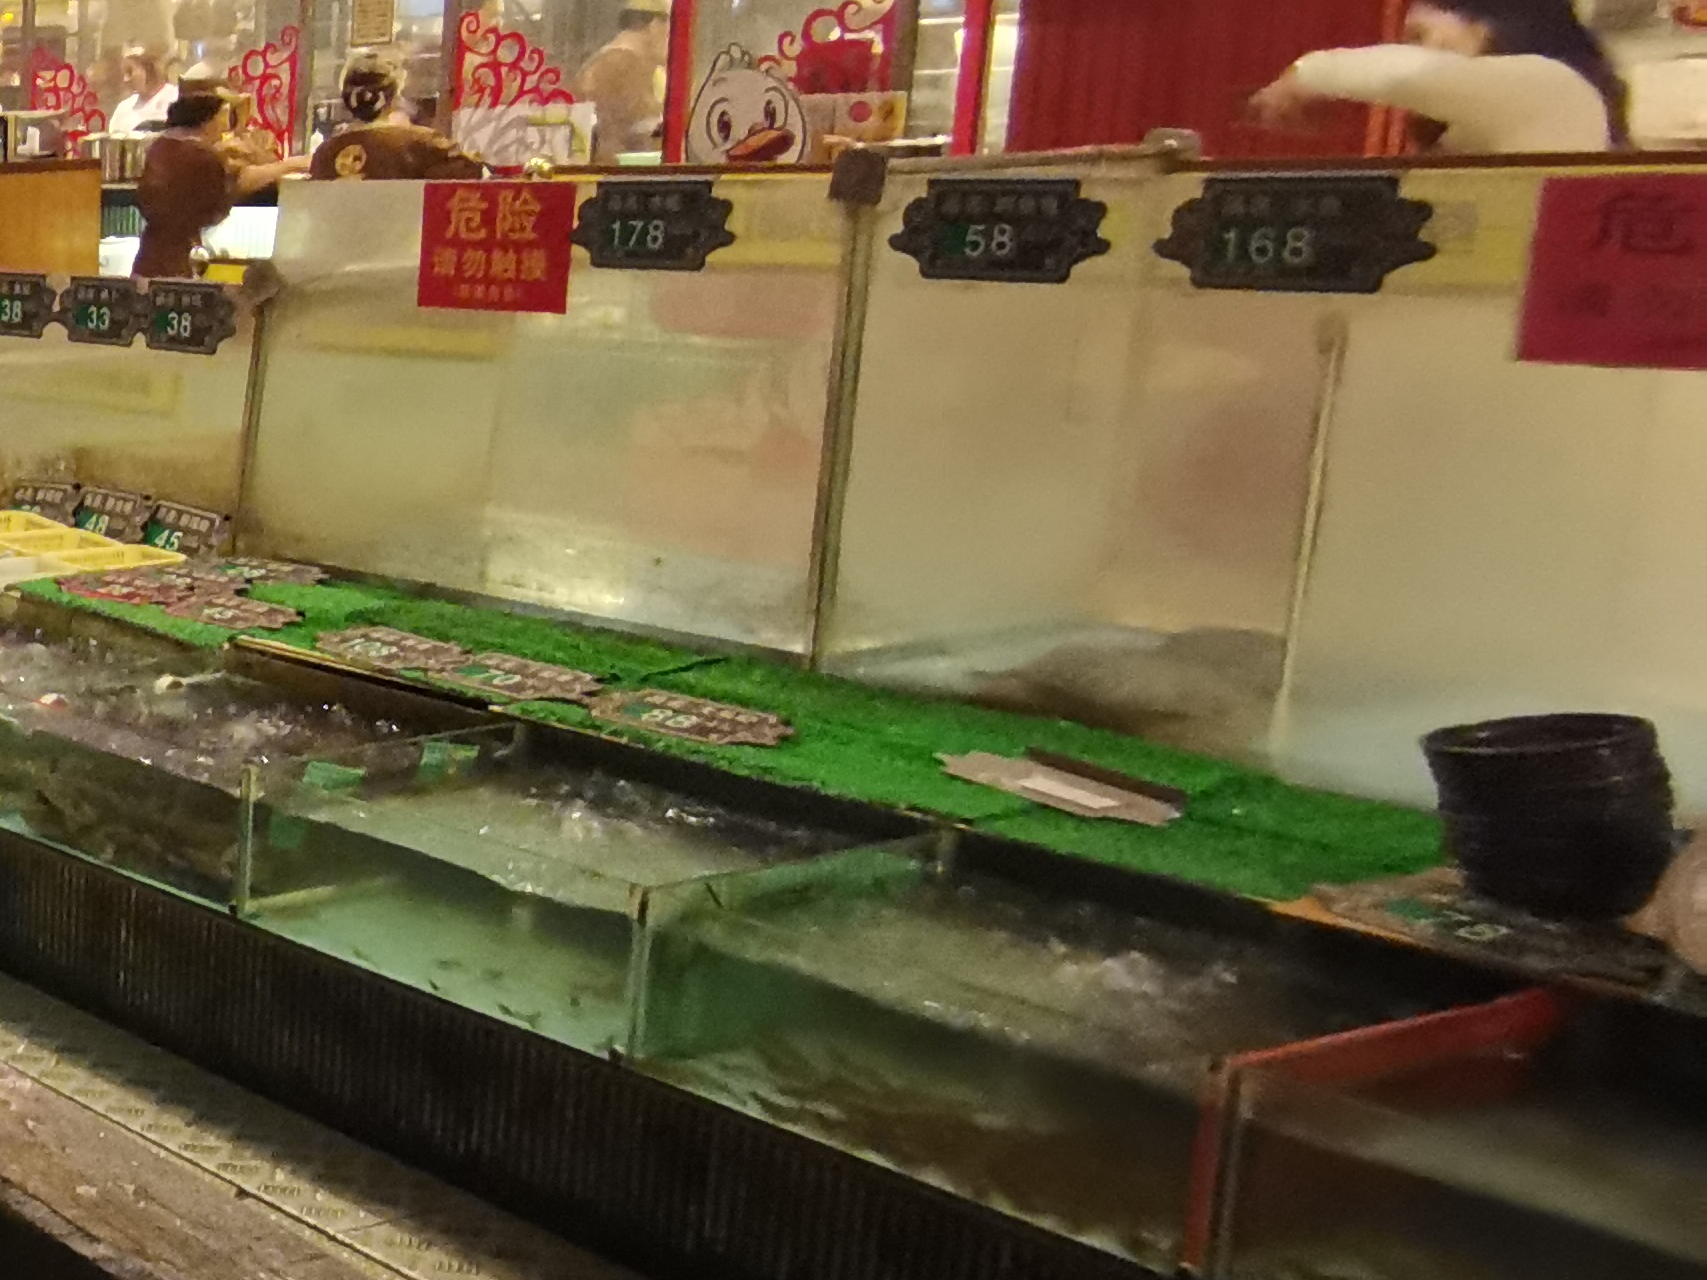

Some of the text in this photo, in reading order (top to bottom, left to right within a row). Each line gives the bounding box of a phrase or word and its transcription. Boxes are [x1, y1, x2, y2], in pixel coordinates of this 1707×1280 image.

[445, 187, 541, 243] 危险
[611, 219, 666, 251] 178
[963, 223, 1014, 258] 58
[1221, 226, 1317, 264] 168
[0, 298, 22, 322] 38
[86, 305, 111, 331] 33
[166, 311, 192, 338] 38
[154, 529, 183, 552] 45
